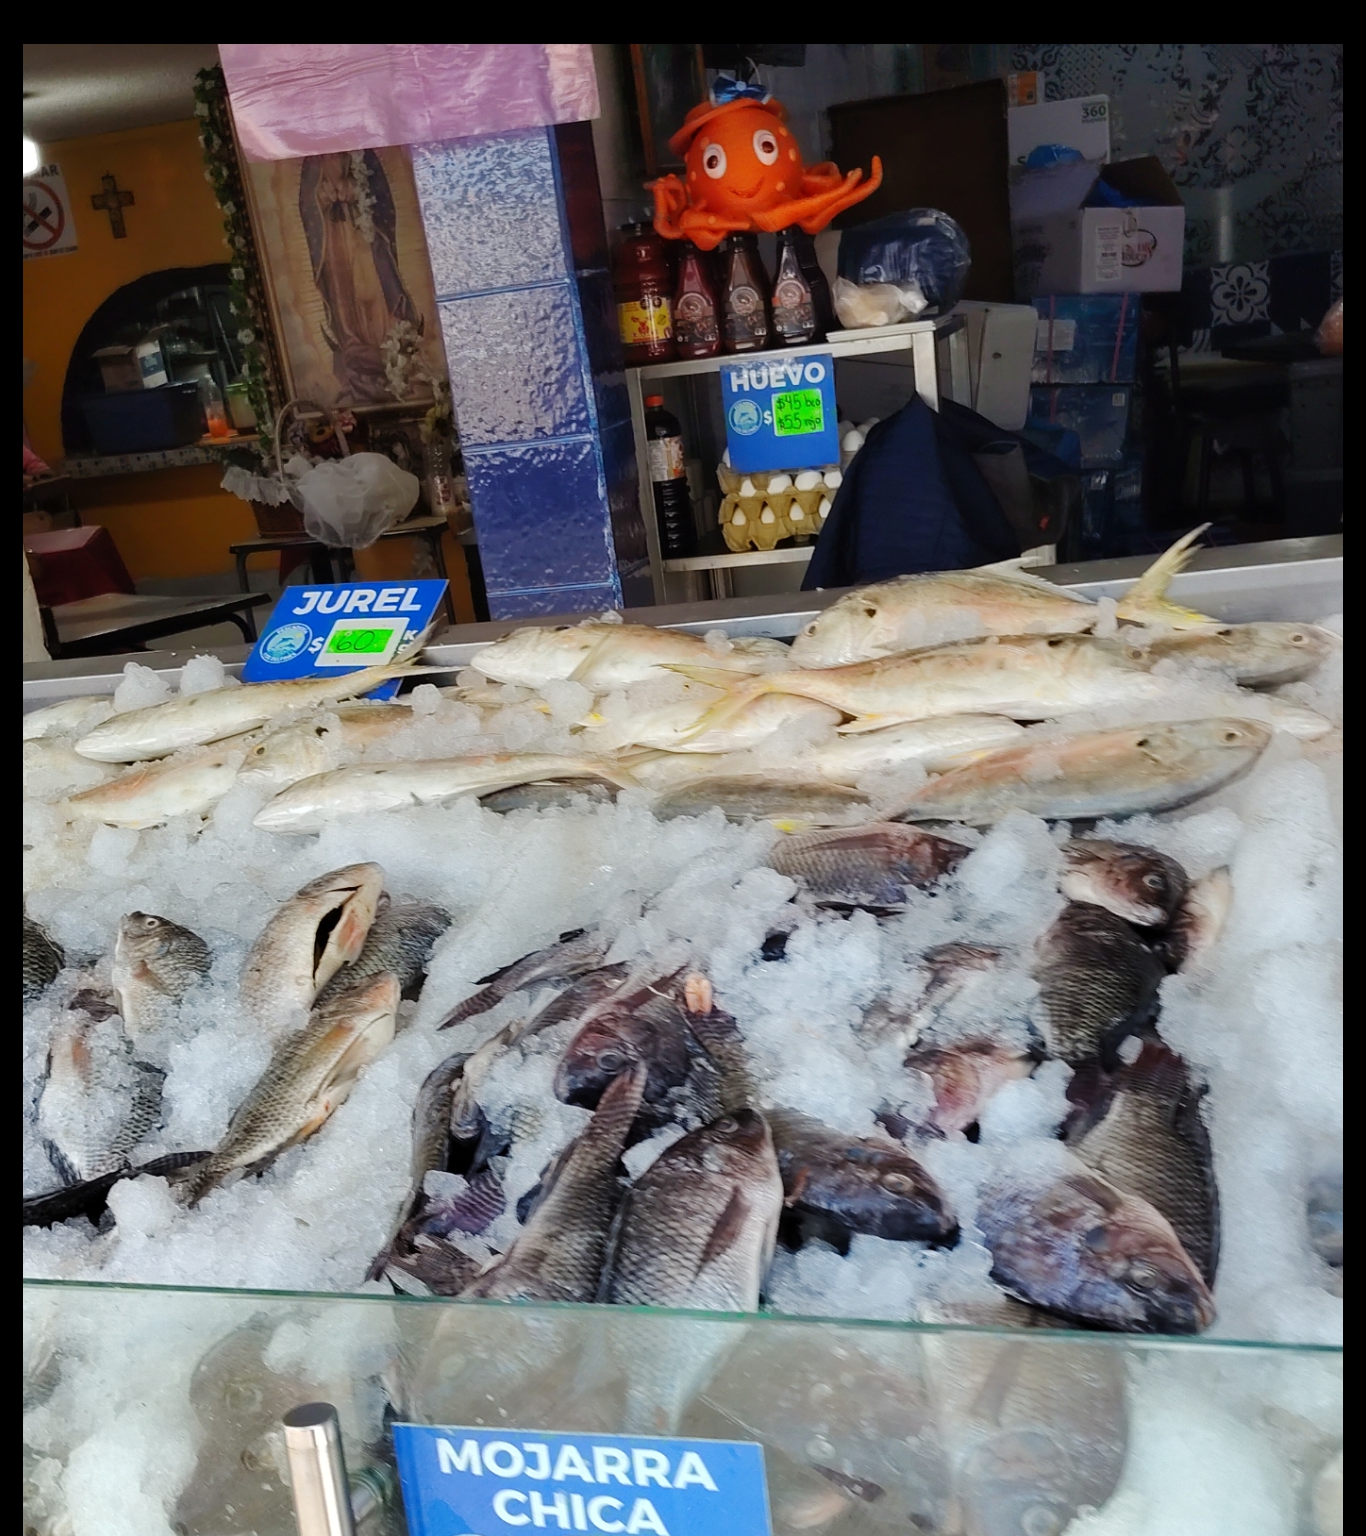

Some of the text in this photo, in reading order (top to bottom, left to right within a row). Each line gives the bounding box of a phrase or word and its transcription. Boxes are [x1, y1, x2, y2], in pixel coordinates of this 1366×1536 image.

[1082, 105, 1107, 118] 360
[730, 361, 826, 393] HUEVO
[292, 587, 423, 616] JUREL
[307, 636, 326, 655] $
[336, 630, 376, 652] 60
[436, 1437, 720, 1492] MOJARRA
